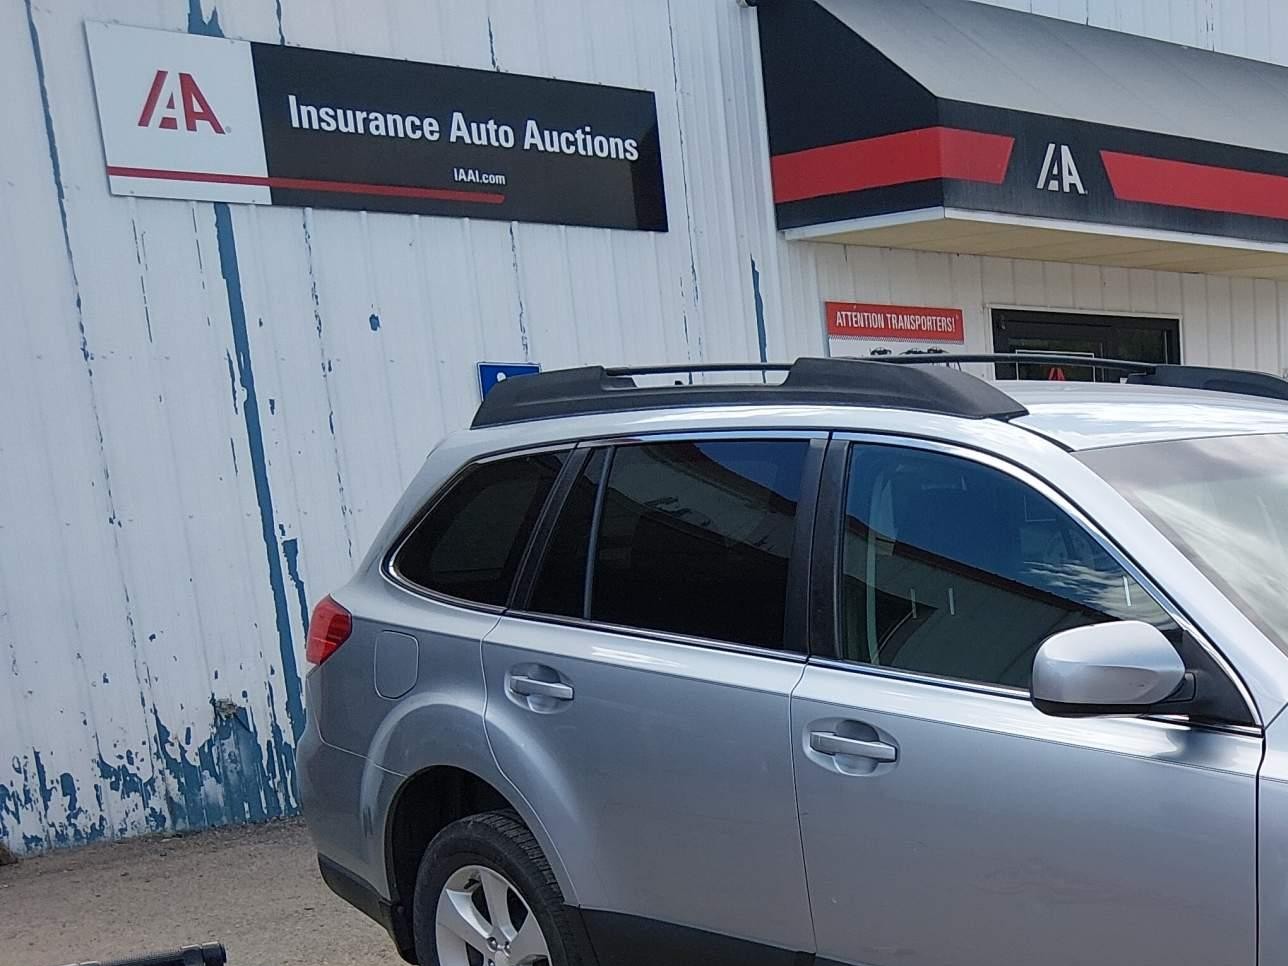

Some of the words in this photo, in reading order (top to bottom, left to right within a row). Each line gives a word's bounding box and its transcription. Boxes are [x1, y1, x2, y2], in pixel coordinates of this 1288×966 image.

[289, 95, 440, 142] Insurance
[449, 111, 515, 148] Auto
[523, 118, 638, 161] Auctions
[453, 167, 506, 185] IAAI.com
[836, 311, 885, 328] ATTENTION
[887, 313, 956, 333] TRANSPORTERS!
